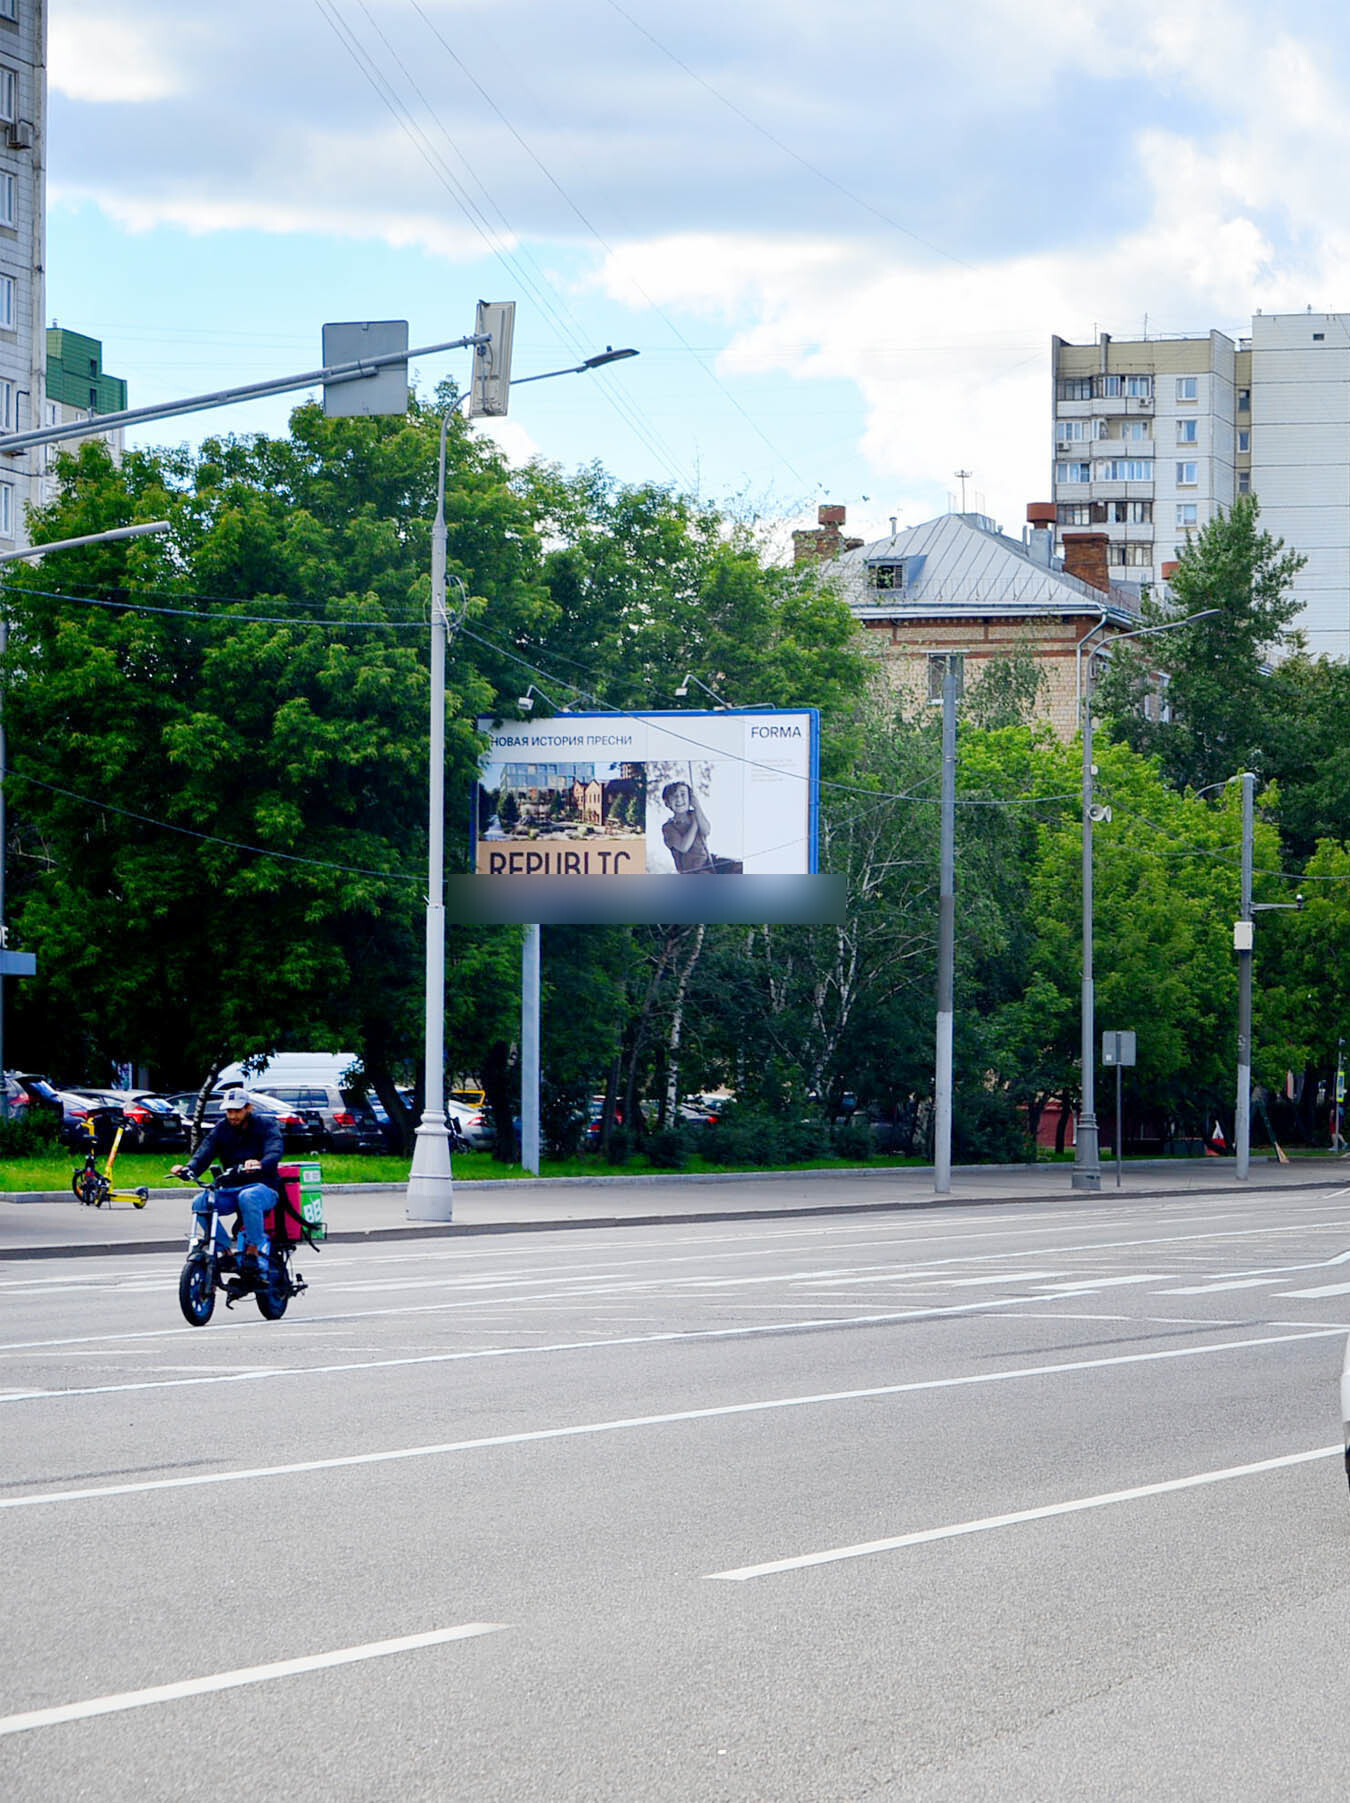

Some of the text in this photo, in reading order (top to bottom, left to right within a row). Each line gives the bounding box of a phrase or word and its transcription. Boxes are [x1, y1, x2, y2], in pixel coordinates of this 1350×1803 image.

[751, 726, 802, 738] FORMA
[492, 735, 632, 747] НОВАЯ ИСТОРИЯ ПРЕСНИ
